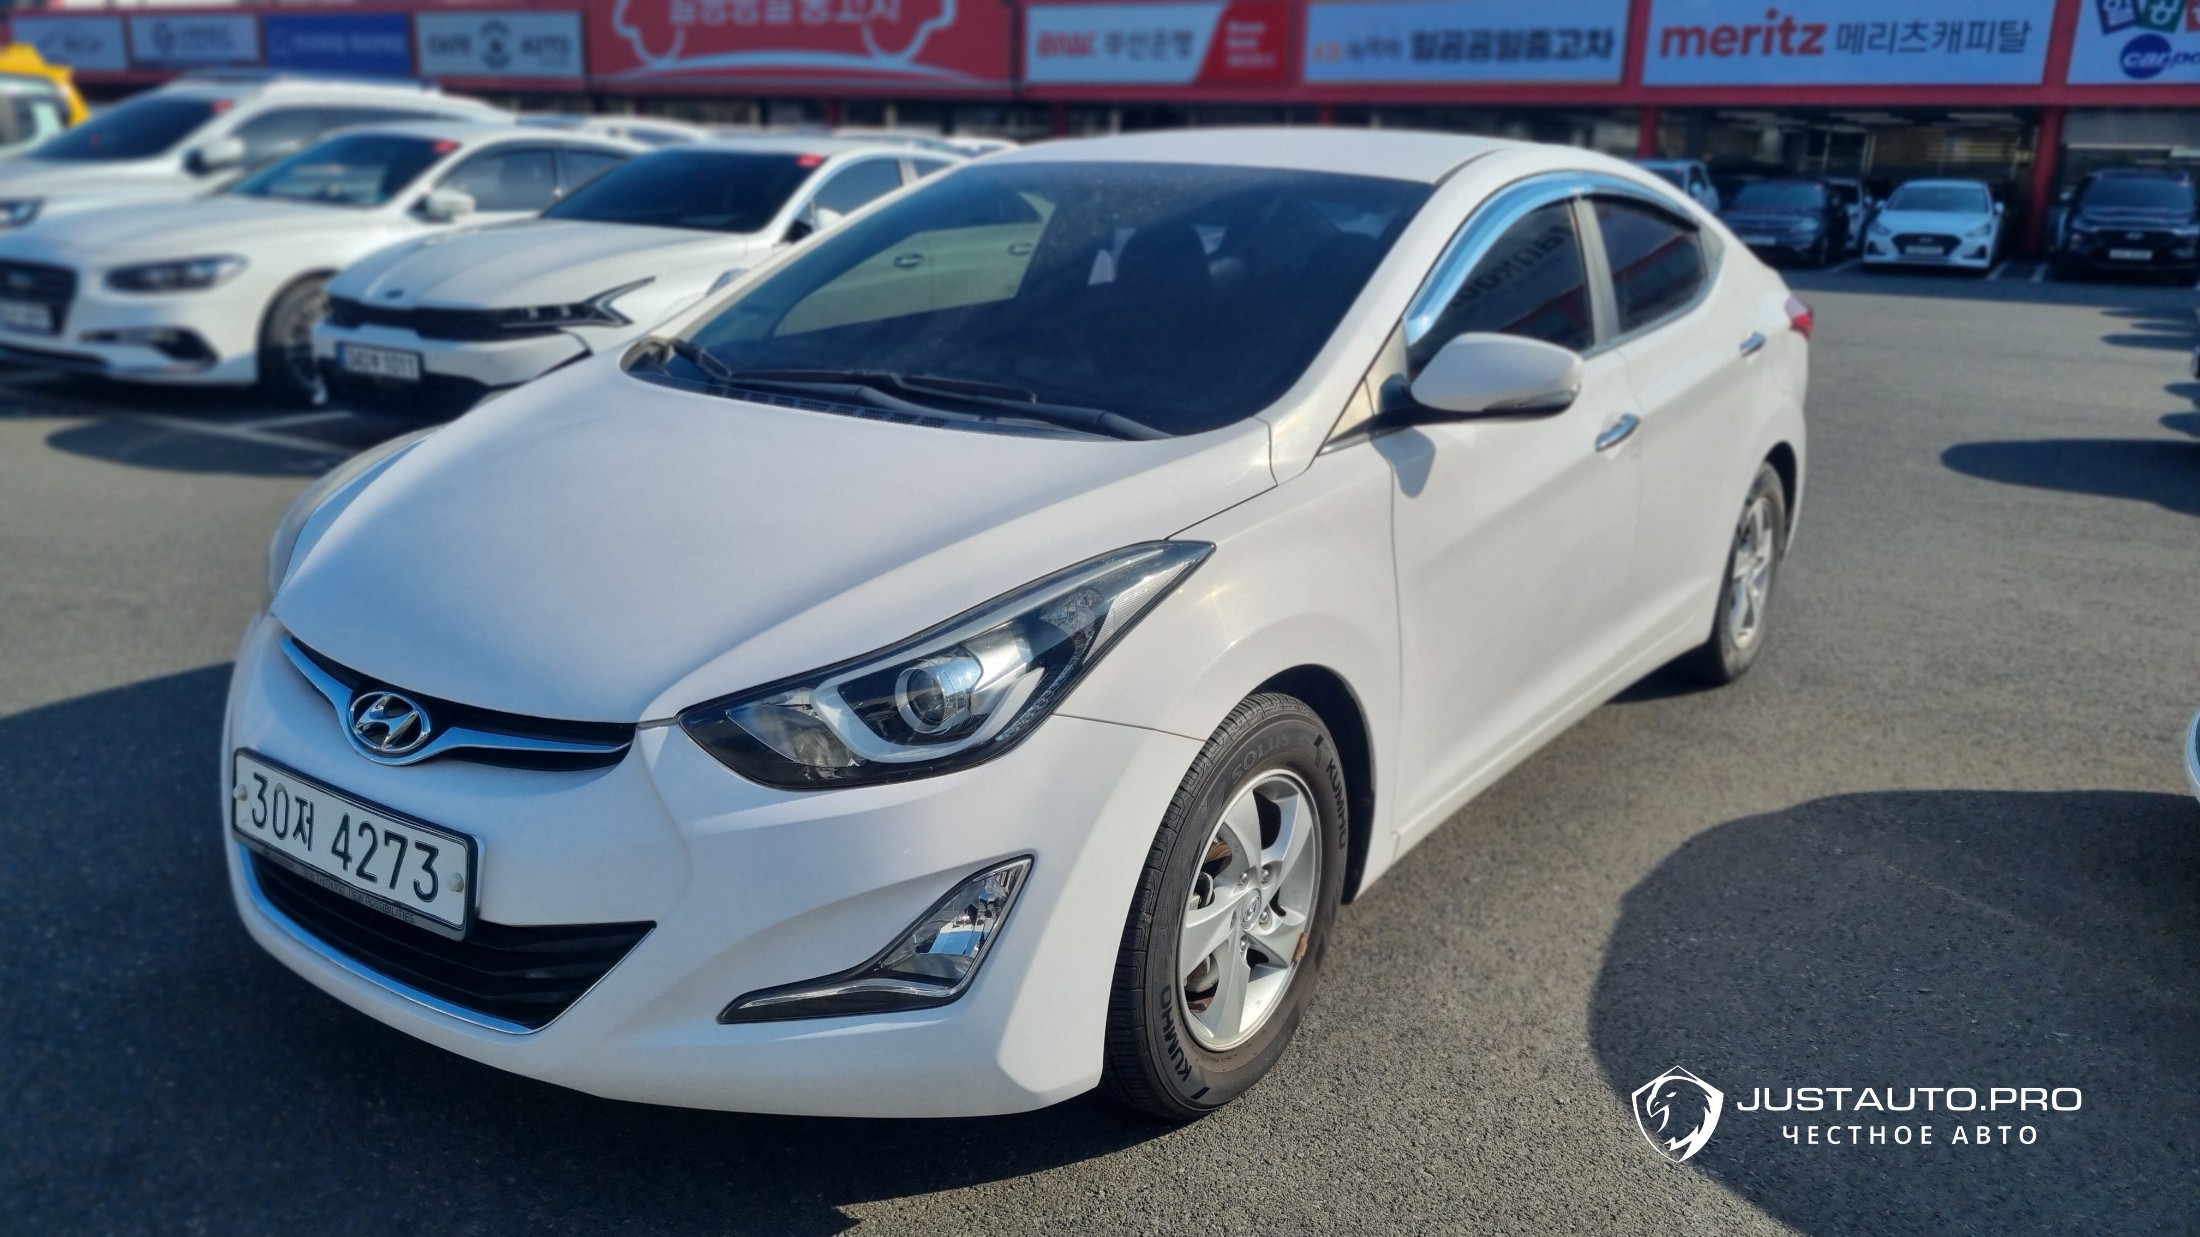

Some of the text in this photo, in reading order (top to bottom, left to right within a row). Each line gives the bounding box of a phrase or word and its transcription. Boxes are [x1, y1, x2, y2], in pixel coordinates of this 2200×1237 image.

[1659, 7, 2034, 58] meritz 메리츠캐피탈
[251, 772, 439, 902] 30저 4273
[1326, 757, 1348, 850] KUMHO
[1160, 985, 1193, 1082] KUMHO
